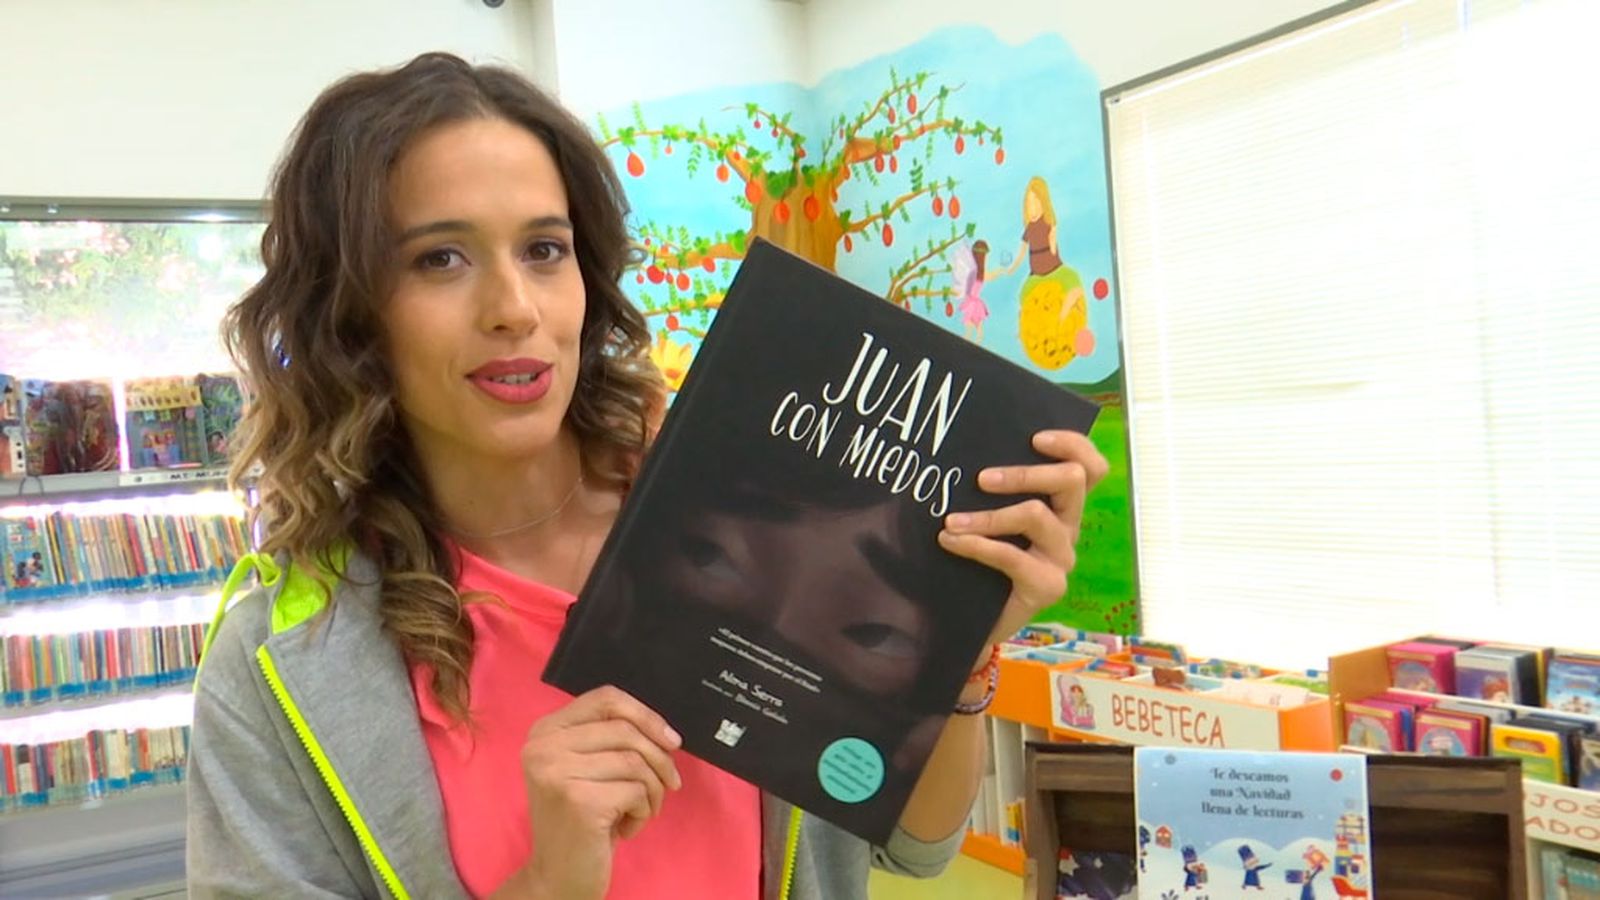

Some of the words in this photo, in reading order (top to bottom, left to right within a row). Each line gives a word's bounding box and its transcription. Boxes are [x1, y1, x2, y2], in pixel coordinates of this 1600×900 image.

[823, 332, 972, 456] JUAN
[770, 391, 842, 458] CON
[719, 670, 748, 690] Alma
[751, 685, 783, 707] Serra
[1111, 694, 1225, 748] BEBETECA
[1209, 767, 1225, 780] Te
[1228, 768, 1289, 783] deseamos
[1209, 788, 1233, 798] una
[1235, 786, 1292, 801] Navidad
[1528, 792, 1600, 819] JOS
[1202, 801, 1232, 815] llena
[1235, 803, 1249, 816] de
[1252, 804, 1305, 819] lecturas
